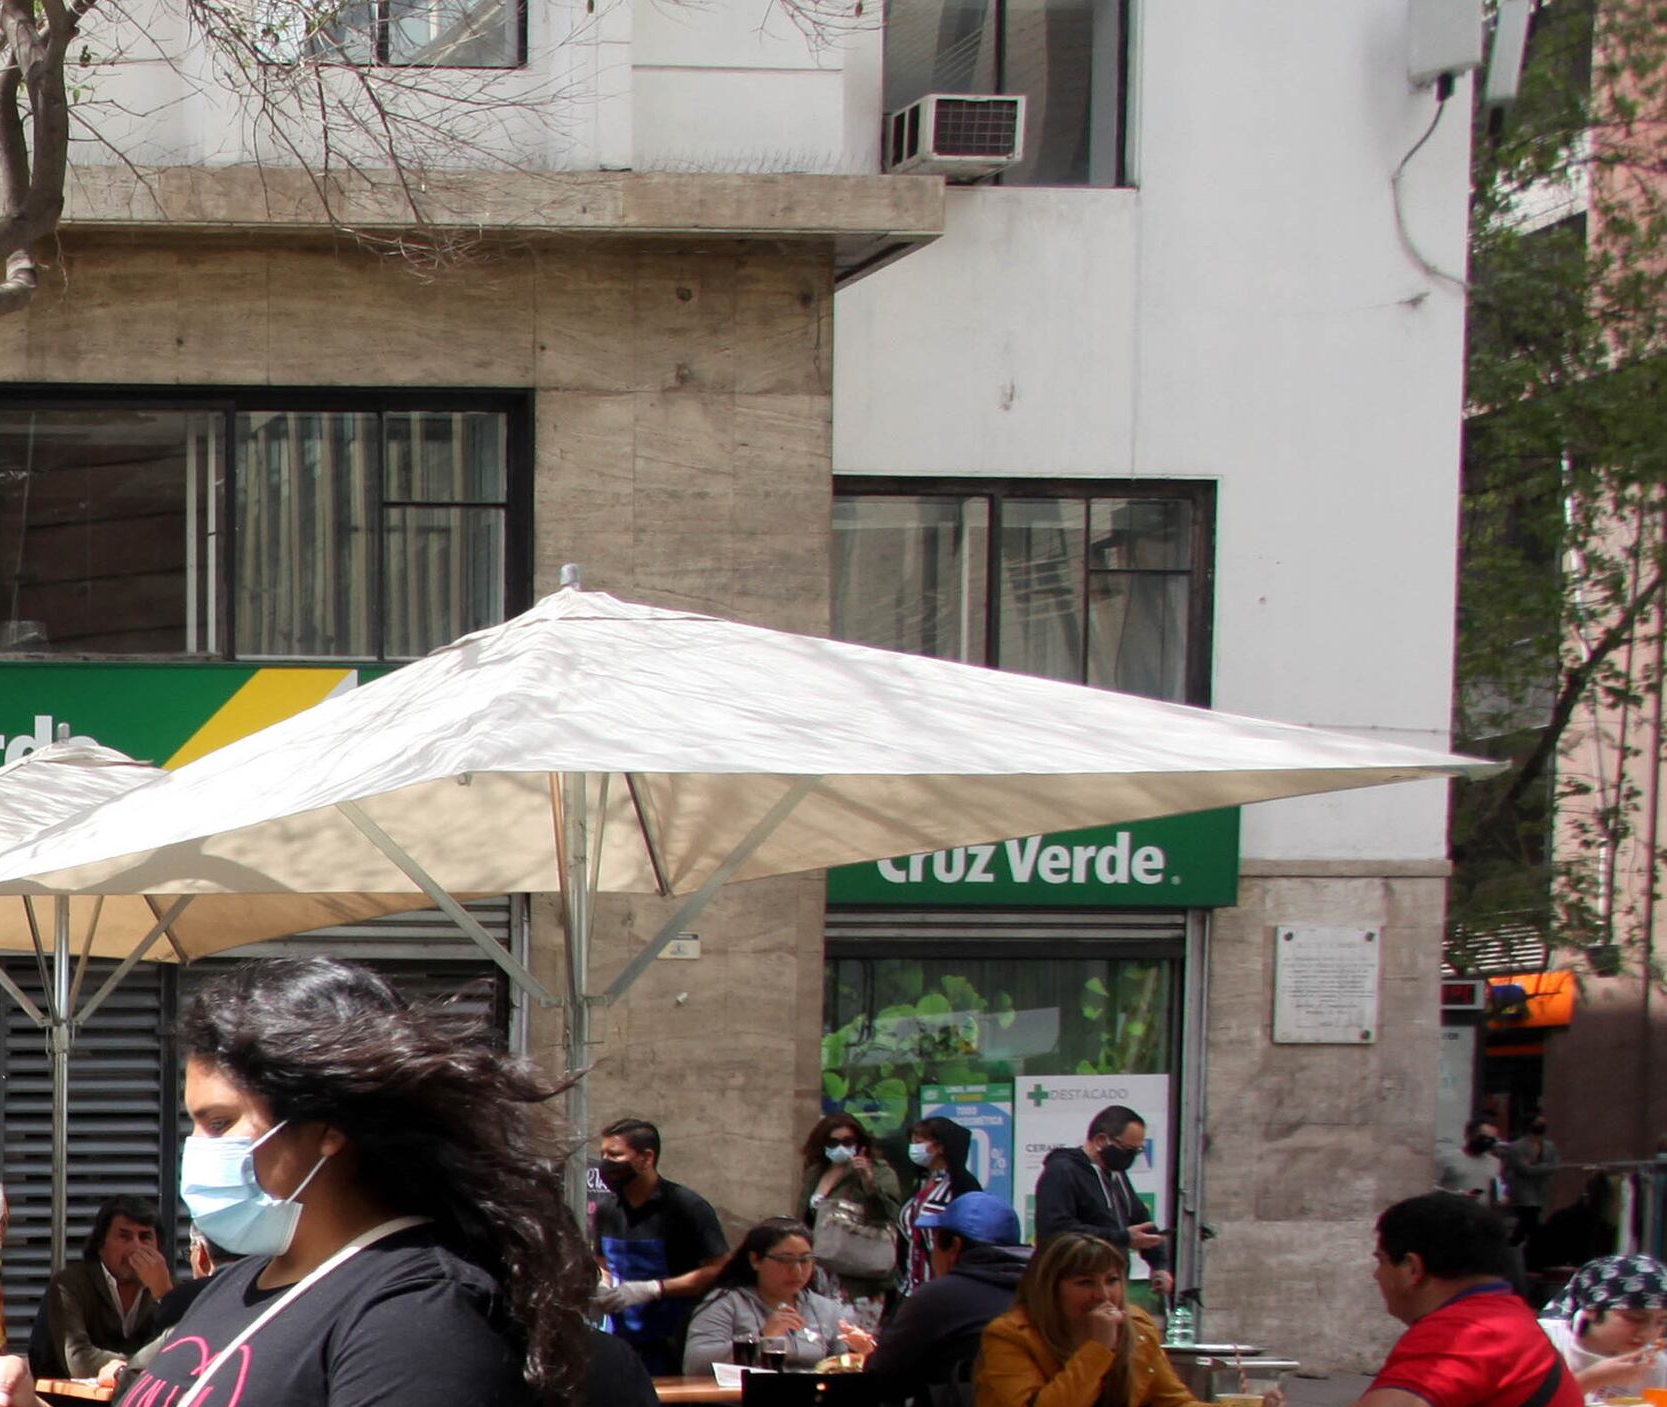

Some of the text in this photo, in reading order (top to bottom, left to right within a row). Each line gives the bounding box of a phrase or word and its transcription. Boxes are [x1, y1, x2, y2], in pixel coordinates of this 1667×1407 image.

[1005, 831, 1165, 884] Verde
[1051, 1088, 1130, 1101] DESTACADO
[1025, 1143, 1066, 1154] CERA
